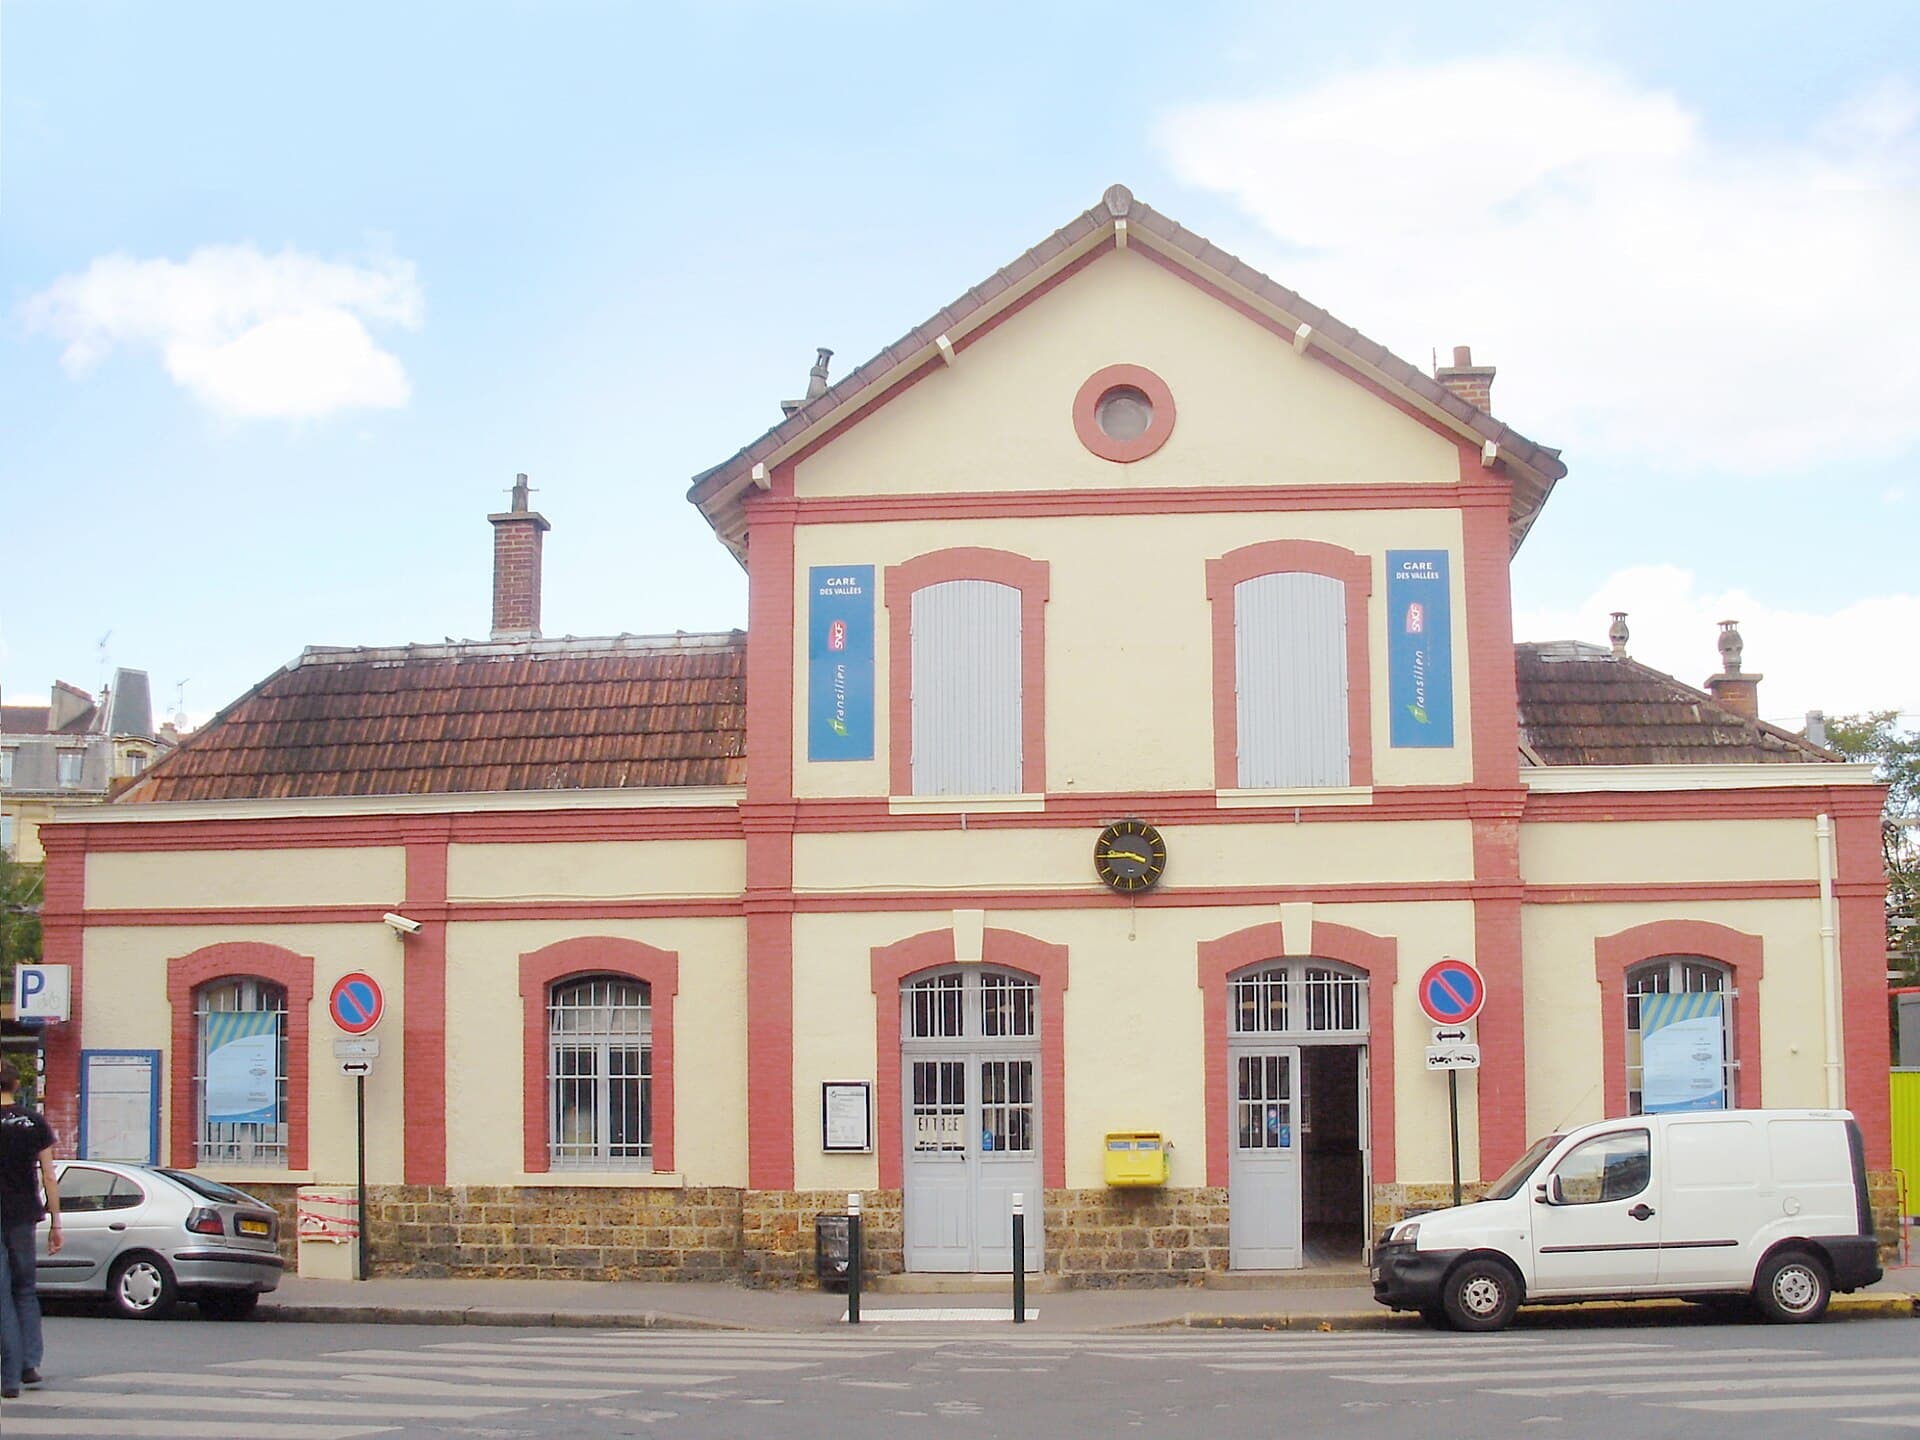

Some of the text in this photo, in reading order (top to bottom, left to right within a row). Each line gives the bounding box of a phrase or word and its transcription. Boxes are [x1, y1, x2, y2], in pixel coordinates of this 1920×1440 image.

[1396, 572, 1410, 580] DES
[1403, 562, 1432, 570] GARE
[819, 588, 833, 596] DES
[827, 577, 856, 586] GARE
[1410, 603, 1421, 632] SNCF
[834, 623, 844, 649] SNCF
[1414, 650, 1425, 717] Transilien
[833, 664, 845, 731] Transilien
[22, 970, 46, 1009] P
